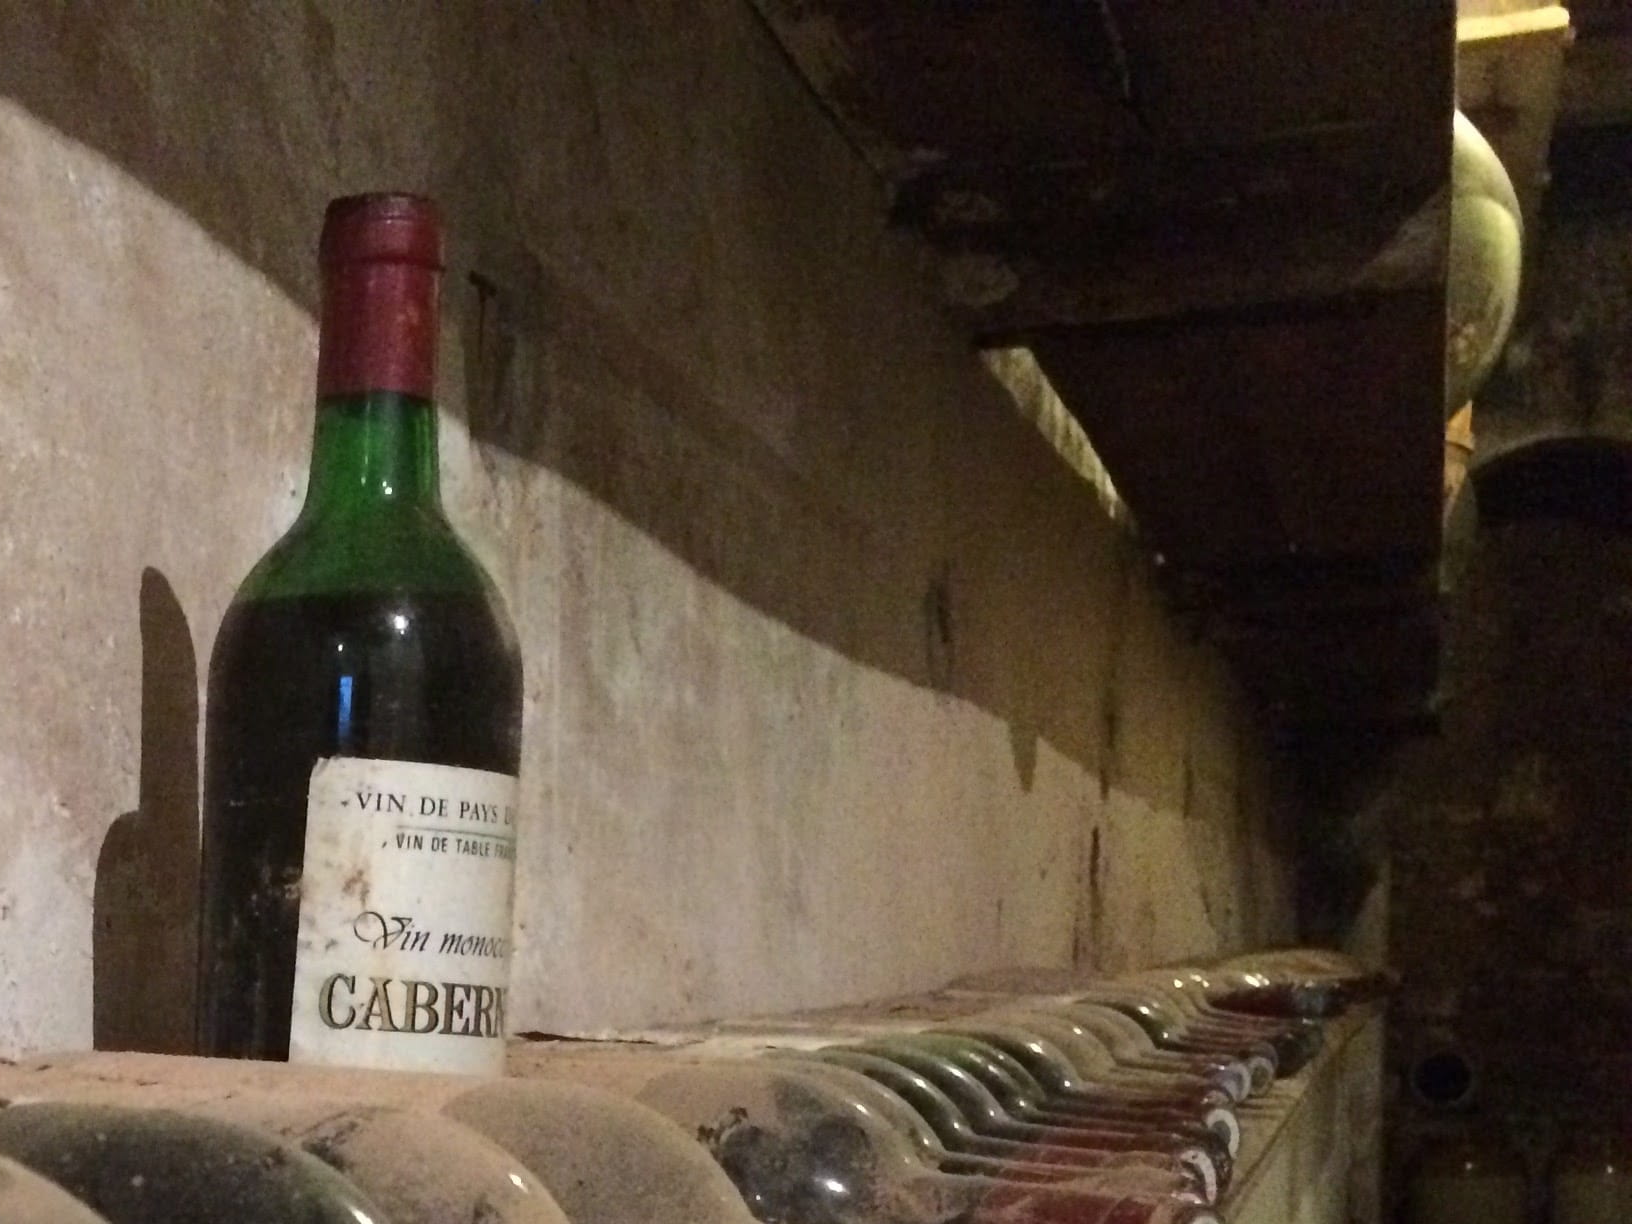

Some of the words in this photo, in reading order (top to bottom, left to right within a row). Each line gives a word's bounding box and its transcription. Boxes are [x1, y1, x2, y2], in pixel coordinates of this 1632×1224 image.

[356, 792, 405, 813] VIN
[419, 796, 449, 817] DE
[458, 800, 498, 824] PAYS
[396, 832, 423, 850] VIN
[431, 837, 448, 853] DE
[455, 838, 490, 857] TABLE
[353, 911, 429, 953] Vin
